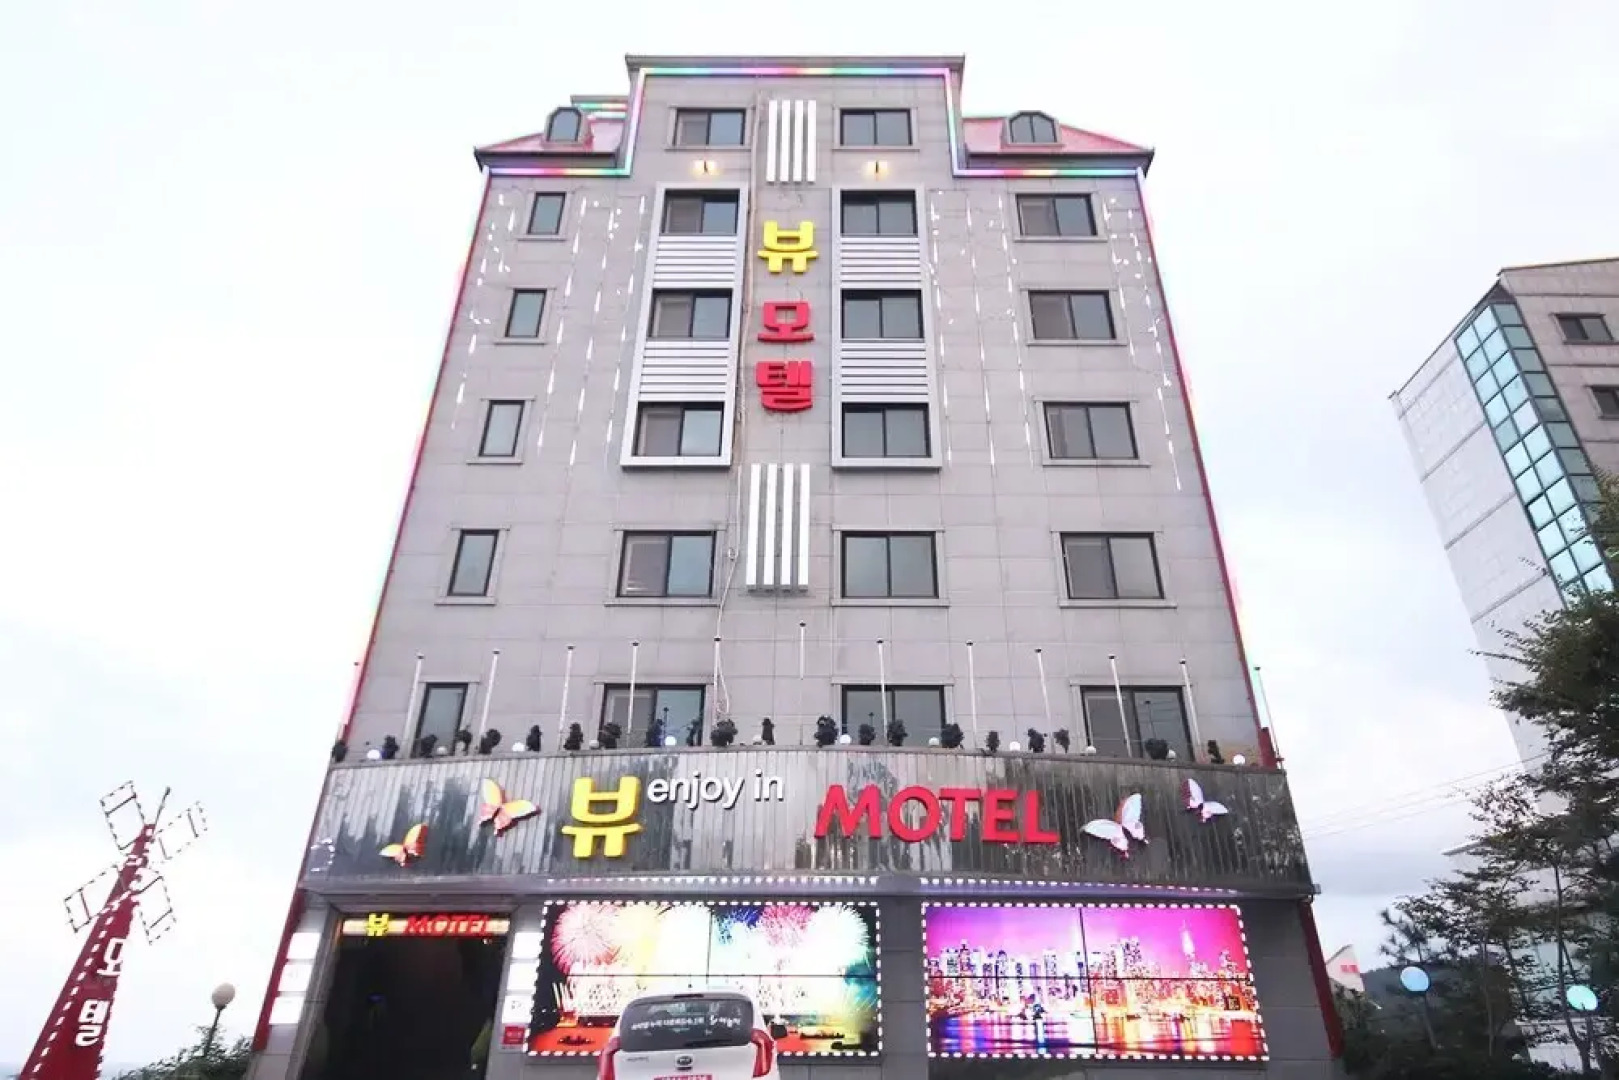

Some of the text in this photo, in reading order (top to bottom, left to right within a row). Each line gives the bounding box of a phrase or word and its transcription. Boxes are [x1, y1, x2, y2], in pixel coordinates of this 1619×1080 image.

[756, 219, 819, 412] 뷰 모텔
[561, 768, 1061, 858] 뷰 enjoy in MOTEL
[366, 912, 490, 937] 뷰 MOTEL
